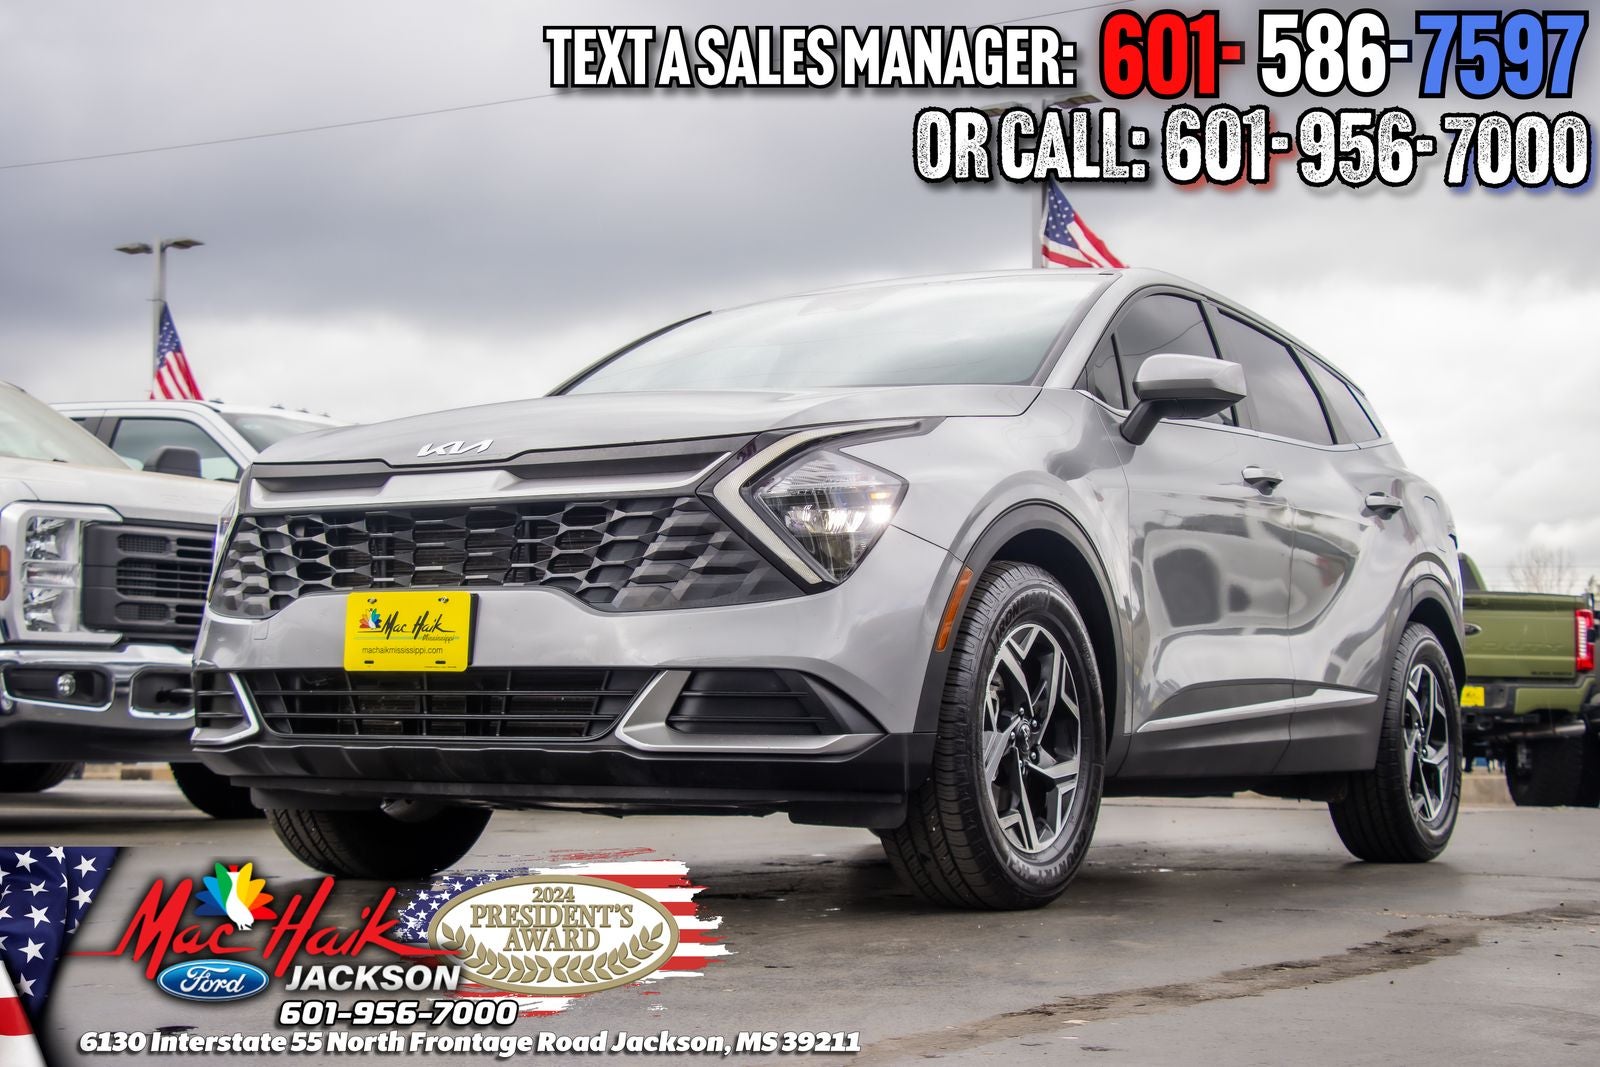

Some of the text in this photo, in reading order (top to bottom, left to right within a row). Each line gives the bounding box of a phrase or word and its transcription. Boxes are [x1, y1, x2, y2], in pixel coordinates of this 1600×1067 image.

[381, 610, 452, 640] Mac Haik
[361, 645, 443, 655] machaikmississippi.com
